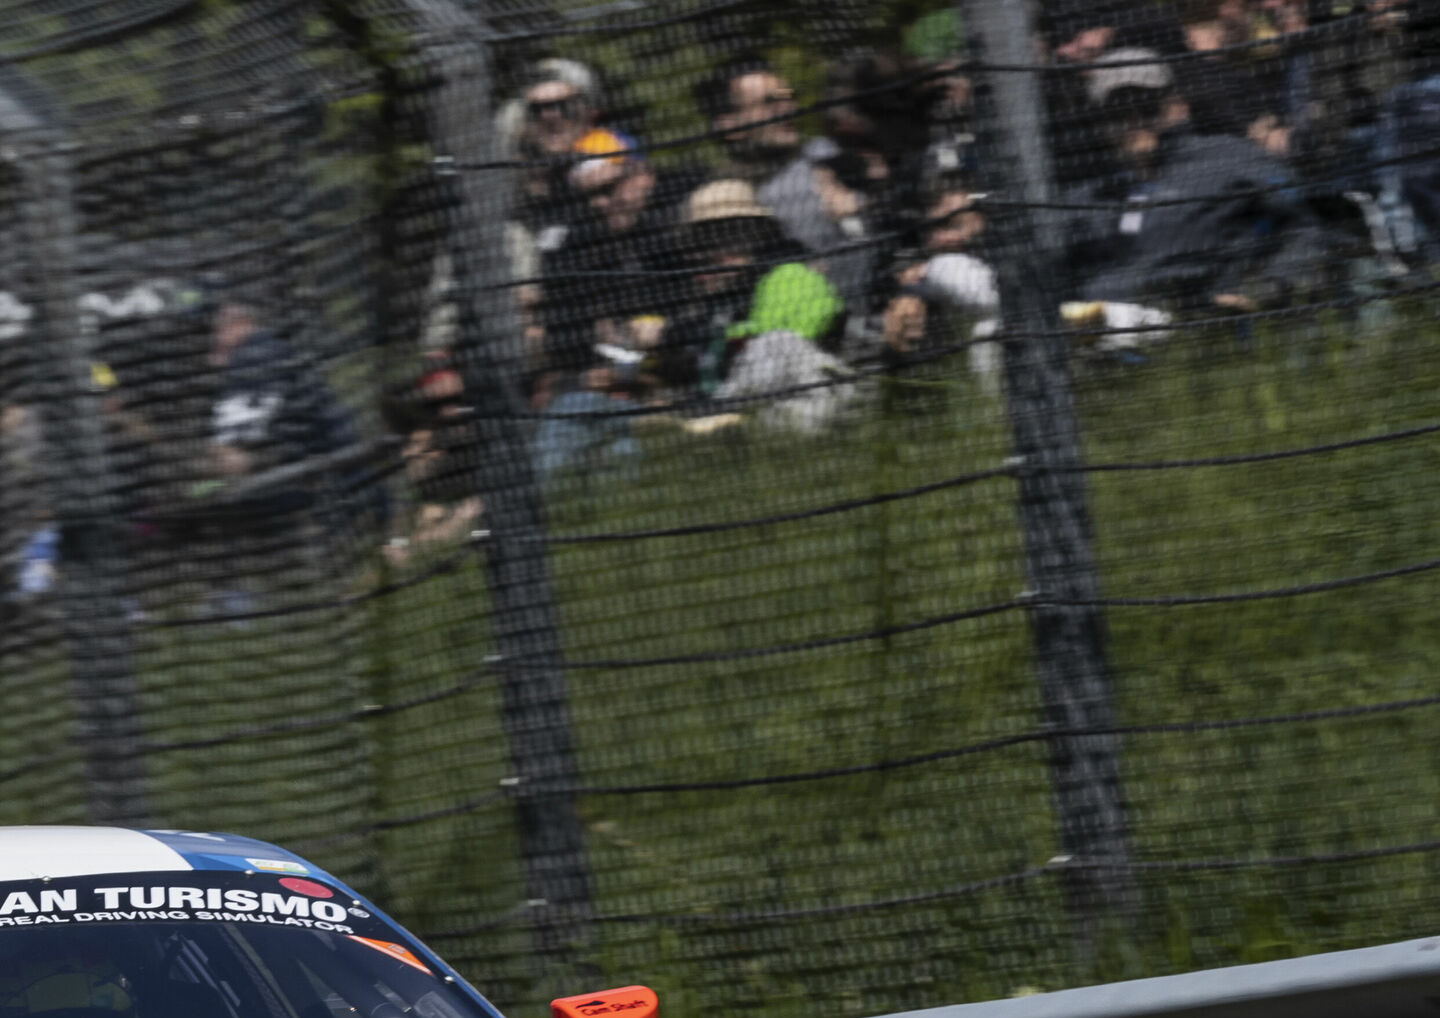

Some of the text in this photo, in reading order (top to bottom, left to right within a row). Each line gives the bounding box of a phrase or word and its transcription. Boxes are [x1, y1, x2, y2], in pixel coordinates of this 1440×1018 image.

[93, 886, 348, 923] TURISMO
[75, 910, 191, 923] DRIVING
[194, 911, 356, 935] SIMULATOR
